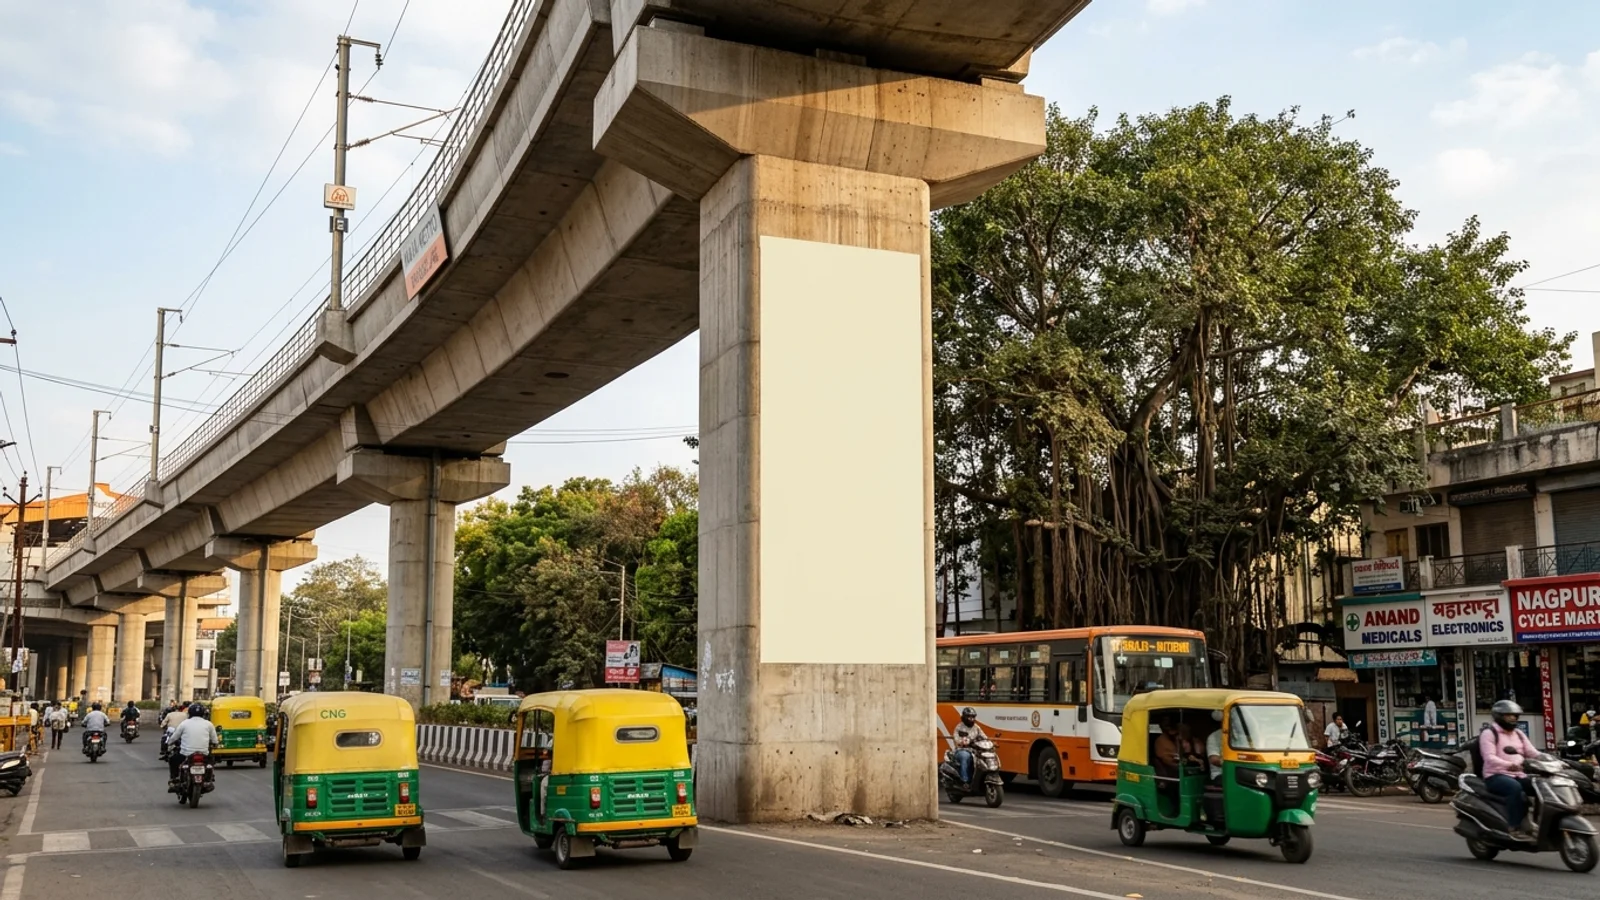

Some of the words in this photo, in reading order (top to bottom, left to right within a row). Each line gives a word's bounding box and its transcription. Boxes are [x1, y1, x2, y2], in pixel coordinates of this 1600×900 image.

[1516, 585, 1600, 611] NAGPUR
[1364, 608, 1420, 627] ANAND
[1518, 611, 1562, 628] CYCLE
[1431, 620, 1505, 636] ELECTRONICS
[1361, 629, 1423, 645] MEDICALS
[320, 708, 347, 720] CNG
